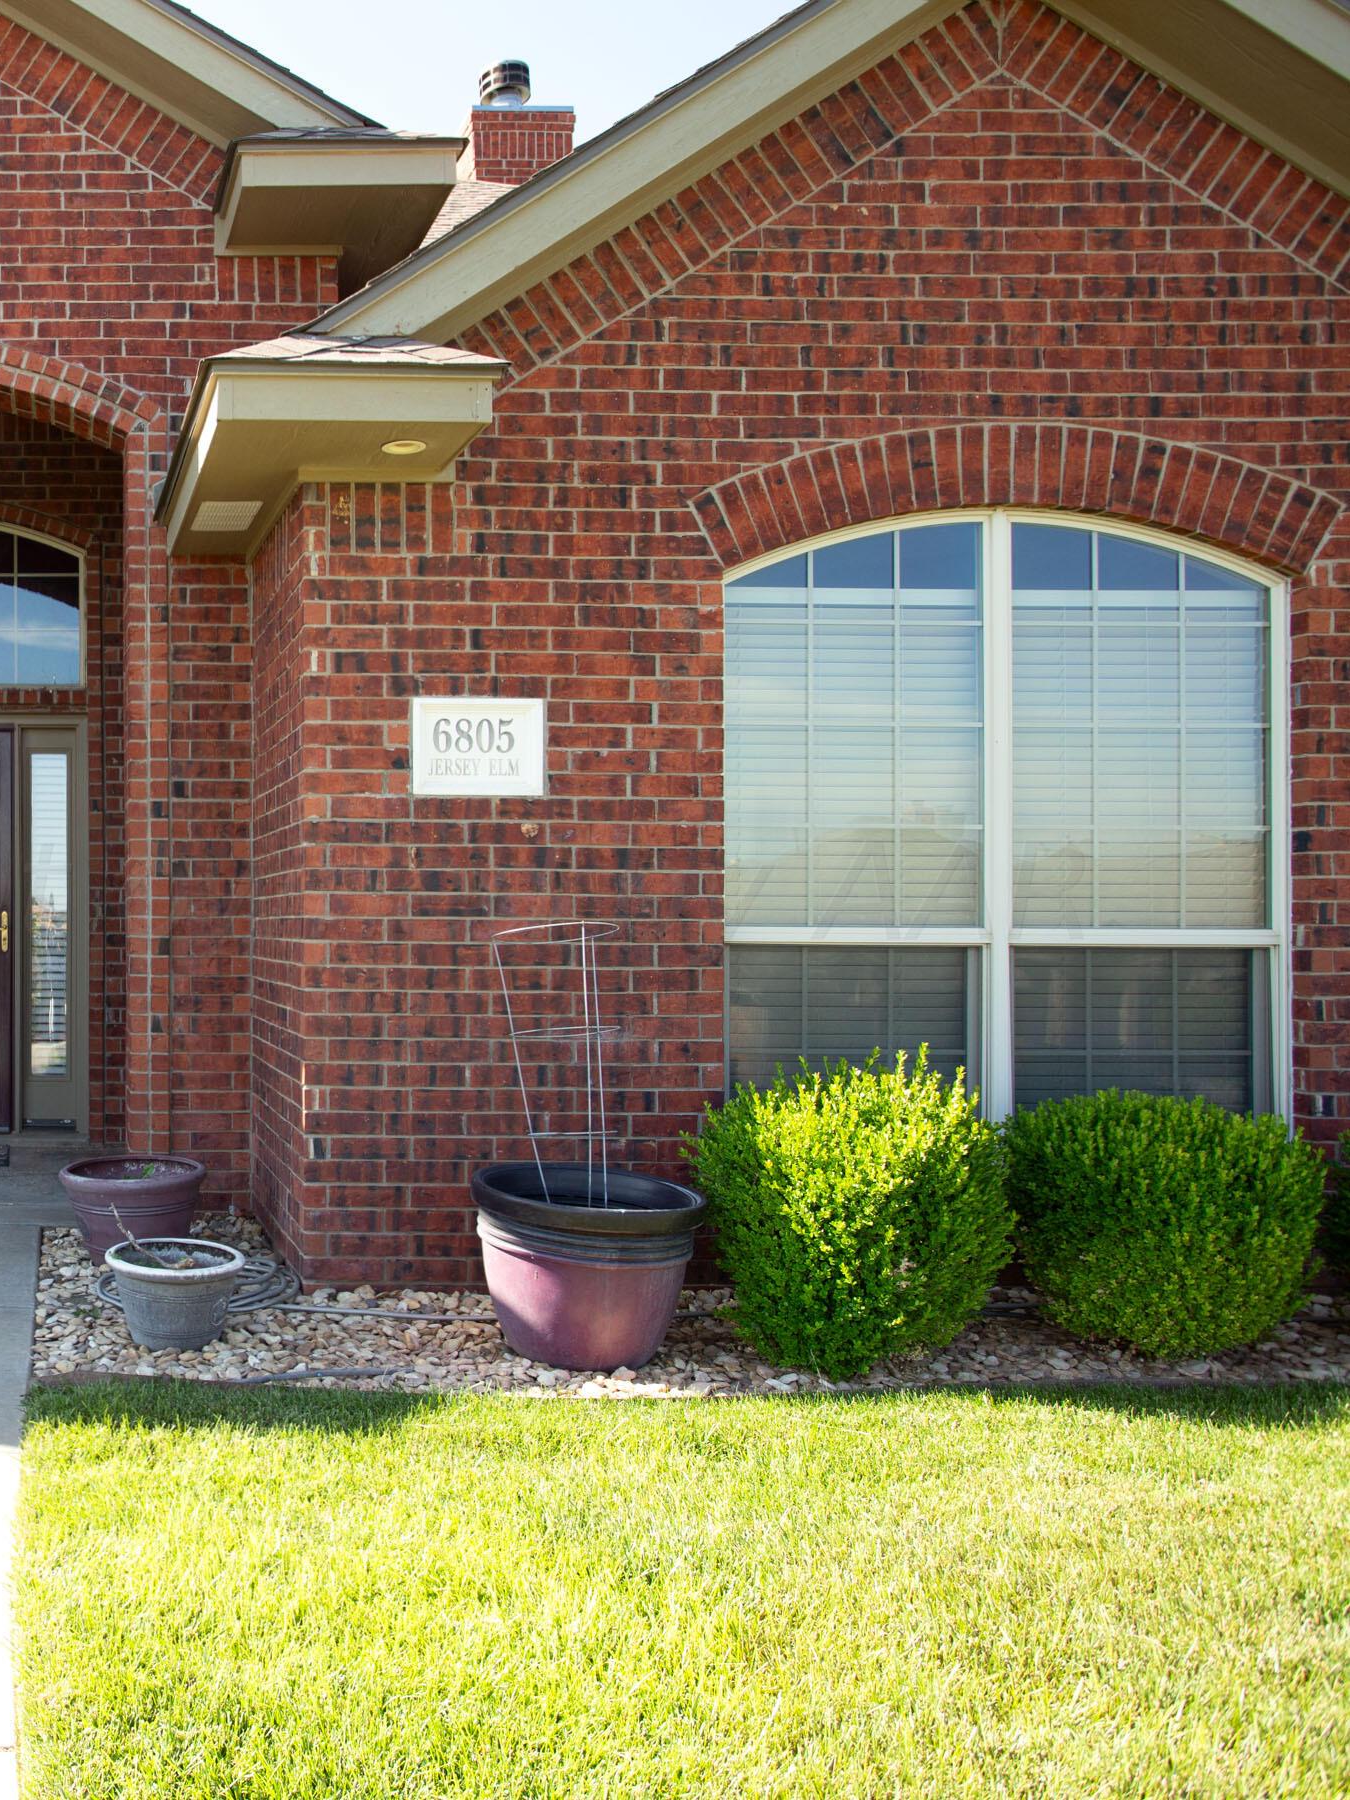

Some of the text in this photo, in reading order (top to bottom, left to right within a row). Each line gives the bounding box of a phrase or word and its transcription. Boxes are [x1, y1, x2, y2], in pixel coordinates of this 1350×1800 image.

[433, 718, 515, 753] 6805
[428, 758, 520, 777] JERSEY ELM
